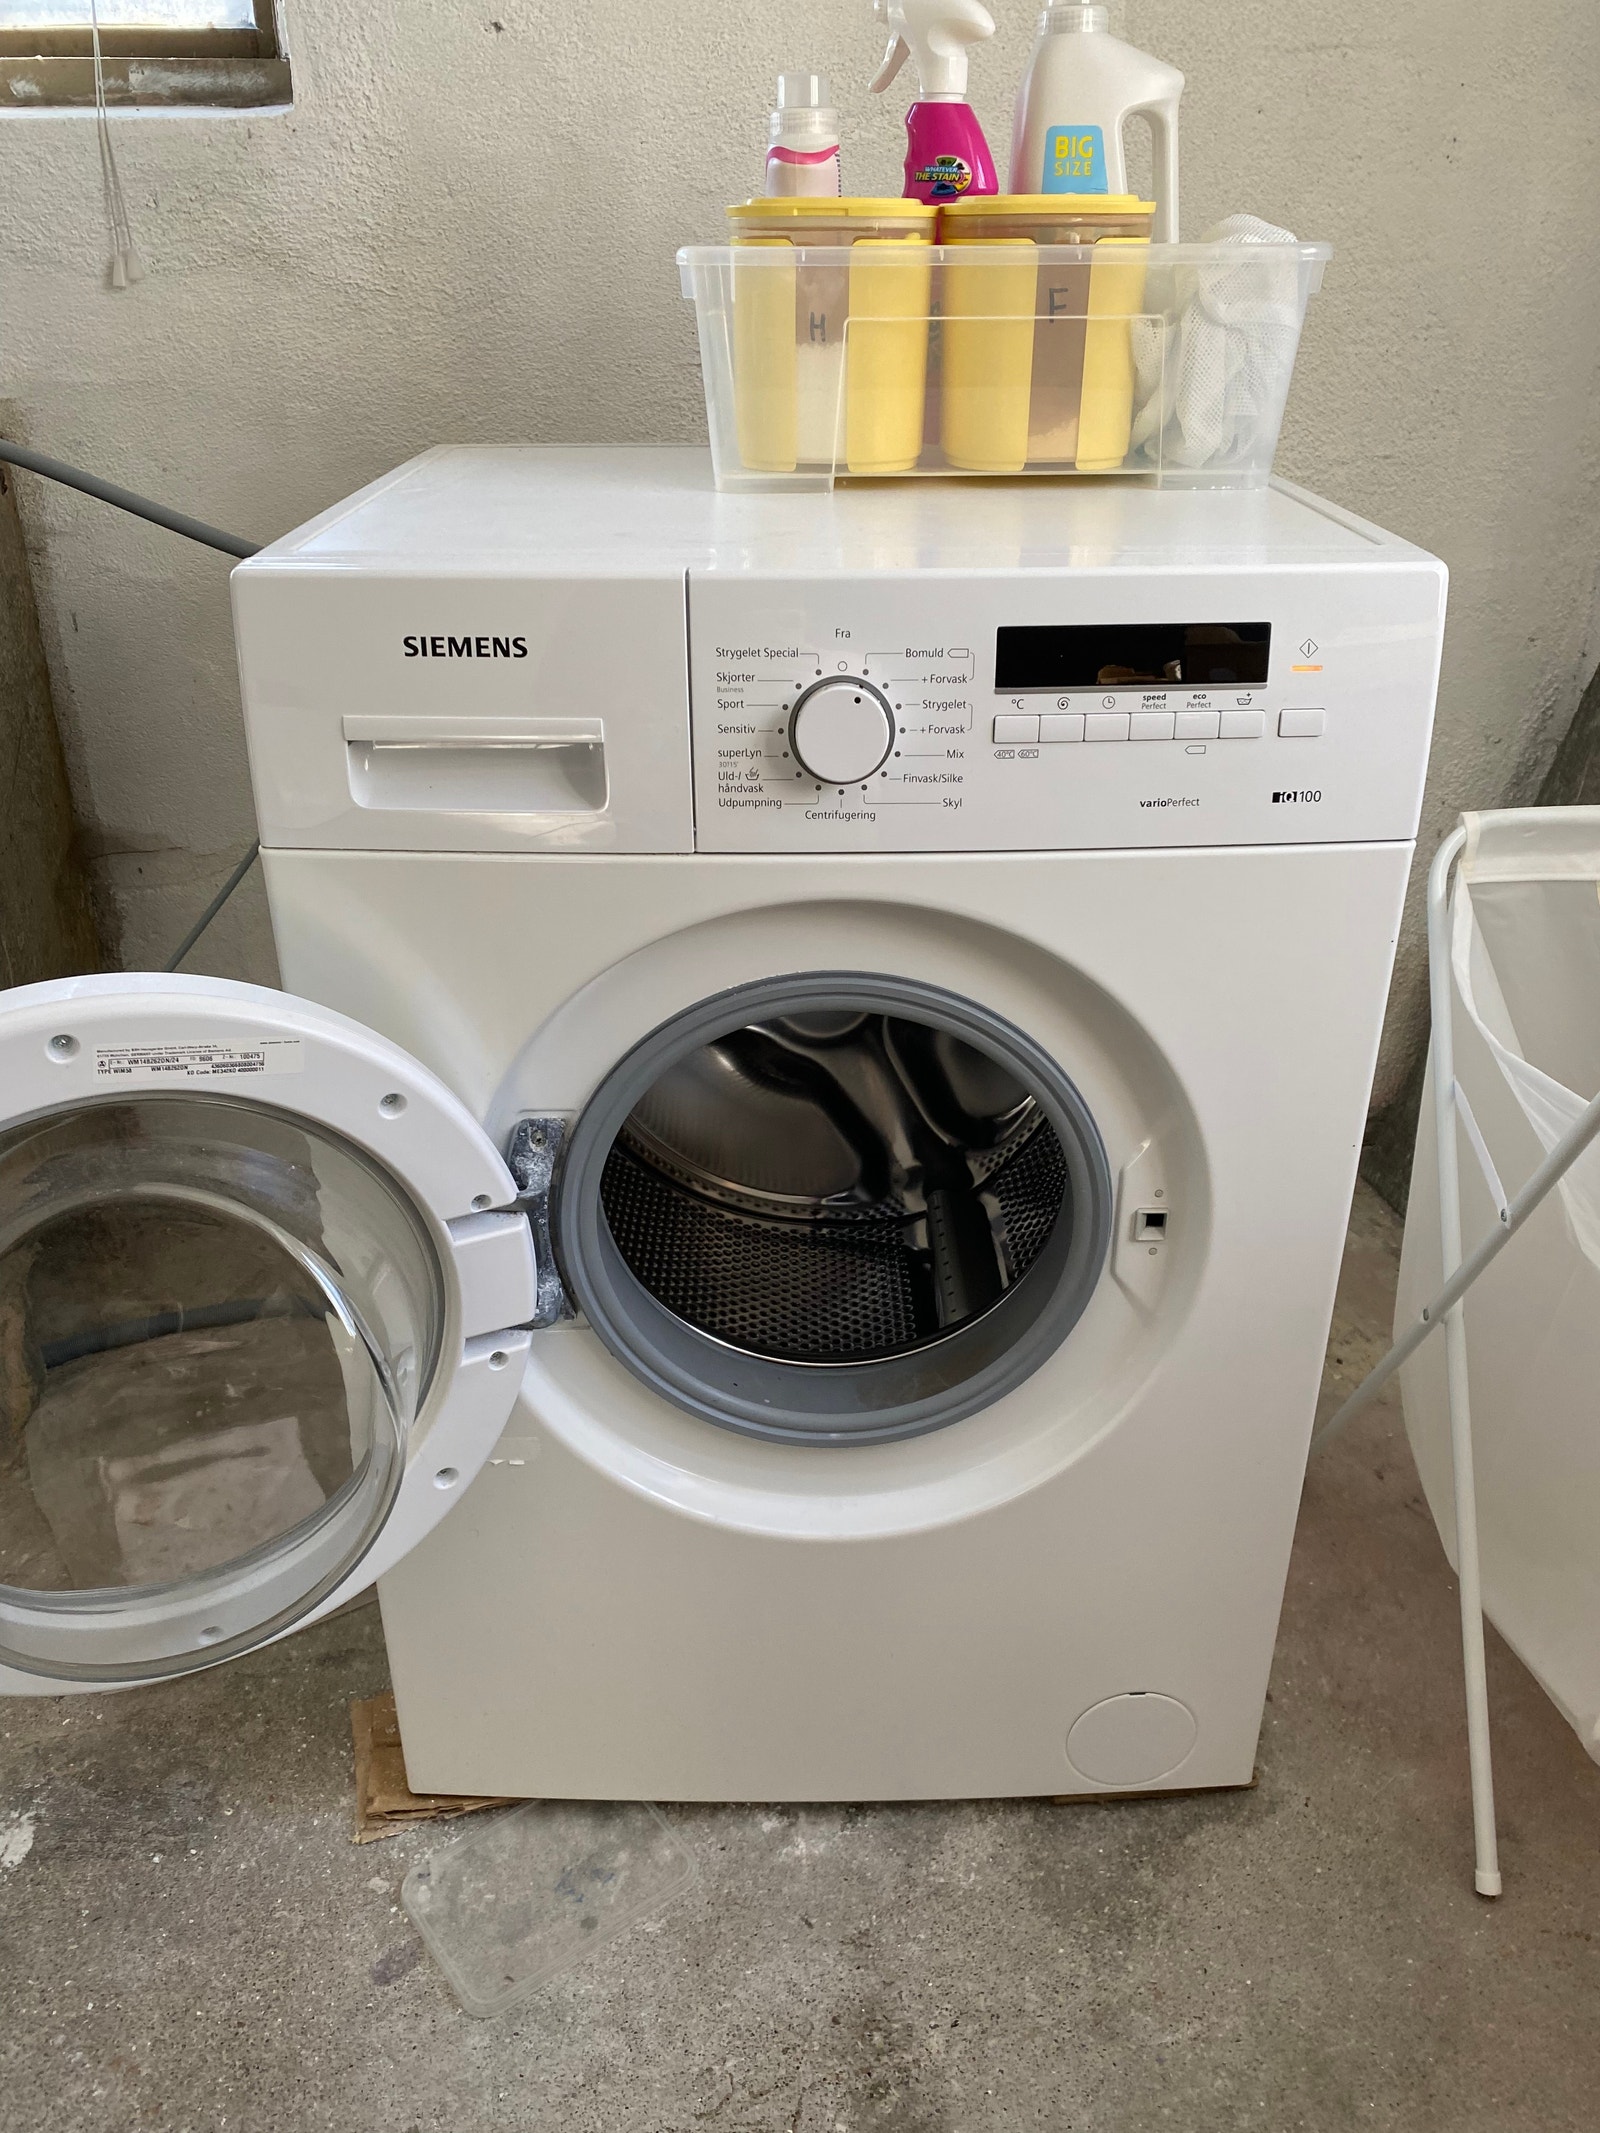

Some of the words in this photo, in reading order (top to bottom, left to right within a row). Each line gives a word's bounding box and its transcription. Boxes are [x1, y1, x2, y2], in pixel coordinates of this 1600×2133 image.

[1055, 135, 1093, 159] BIG
[1054, 161, 1092, 177] SIZE
[915, 172, 930, 181] THE
[931, 172, 960, 182] STAIN
[1049, 287, 1069, 323] F
[809, 311, 827, 342] H
[835, 628, 851, 639] Fra
[403, 636, 528, 658] SIEMENS
[715, 647, 761, 659] Strygelet
[763, 647, 799, 659] Special
[905, 648, 944, 658] Bomuld
[716, 672, 756, 682] Skjorter
[930, 674, 968, 685] Forvask
[1143, 694, 1167, 702] speed
[717, 699, 745, 711] Sport
[922, 699, 967, 711] Strygelet
[1141, 702, 1167, 710] Perfect
[1186, 701, 1212, 709] Perfect
[717, 724, 756, 734] Sensitiv
[928, 724, 966, 735] Forvask
[717, 748, 762, 760] superLyn
[946, 749, 965, 759] Mix
[903, 772, 964, 784] Finvask/Silke
[718, 783, 764, 793] håndvask
[718, 797, 782, 809] Udpumpning
[942, 798, 963, 809] Skyl
[1139, 797, 1200, 808] varioPerfect
[804, 809, 876, 821] Centrifugering
